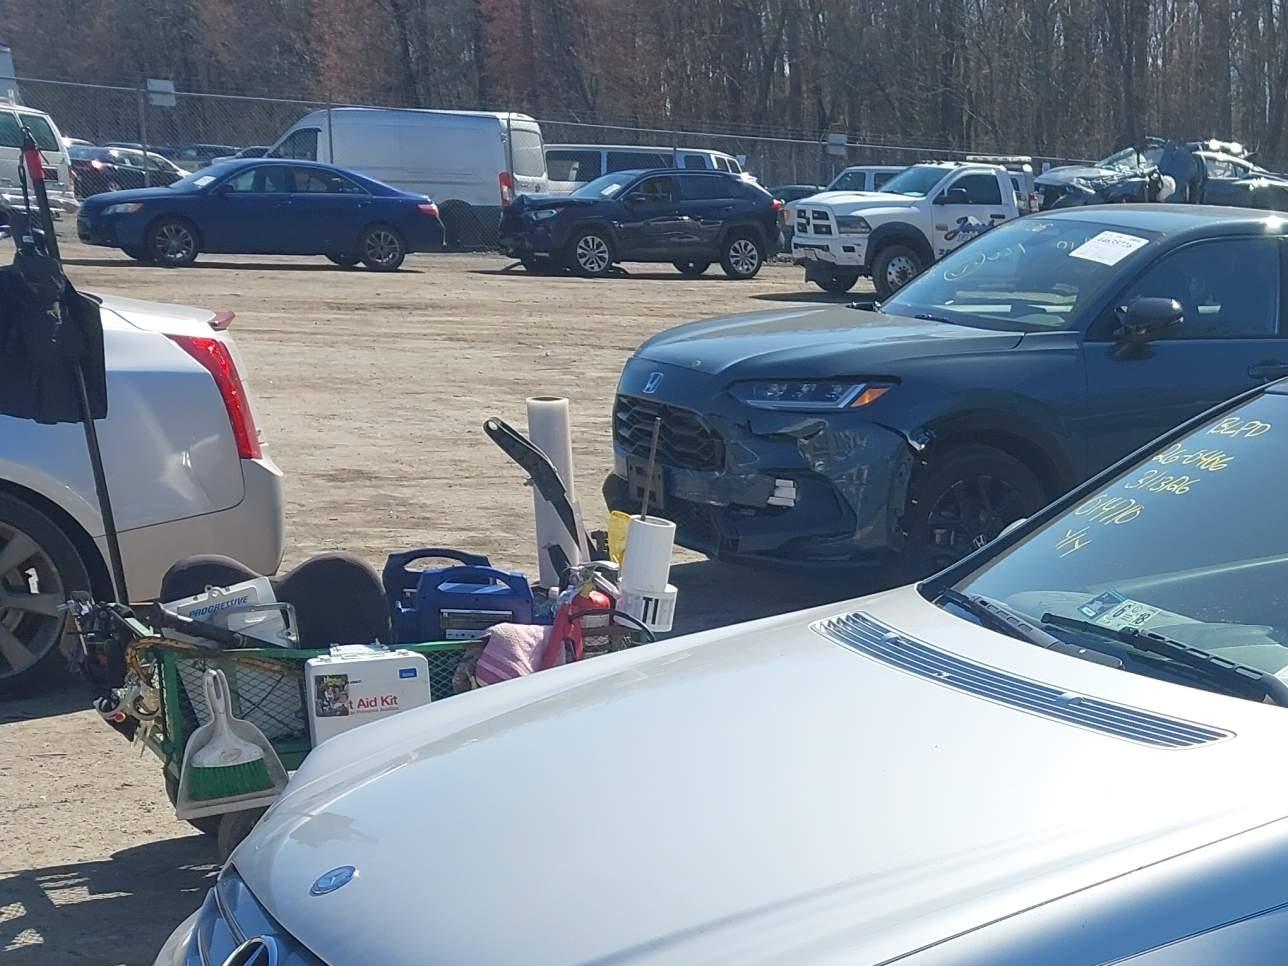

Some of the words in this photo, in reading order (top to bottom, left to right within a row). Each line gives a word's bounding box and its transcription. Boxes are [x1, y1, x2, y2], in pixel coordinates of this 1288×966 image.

[191, 594, 249, 619] PROGRESSIVE
[357, 696, 378, 710] Aid
[380, 694, 399, 707] Kit
